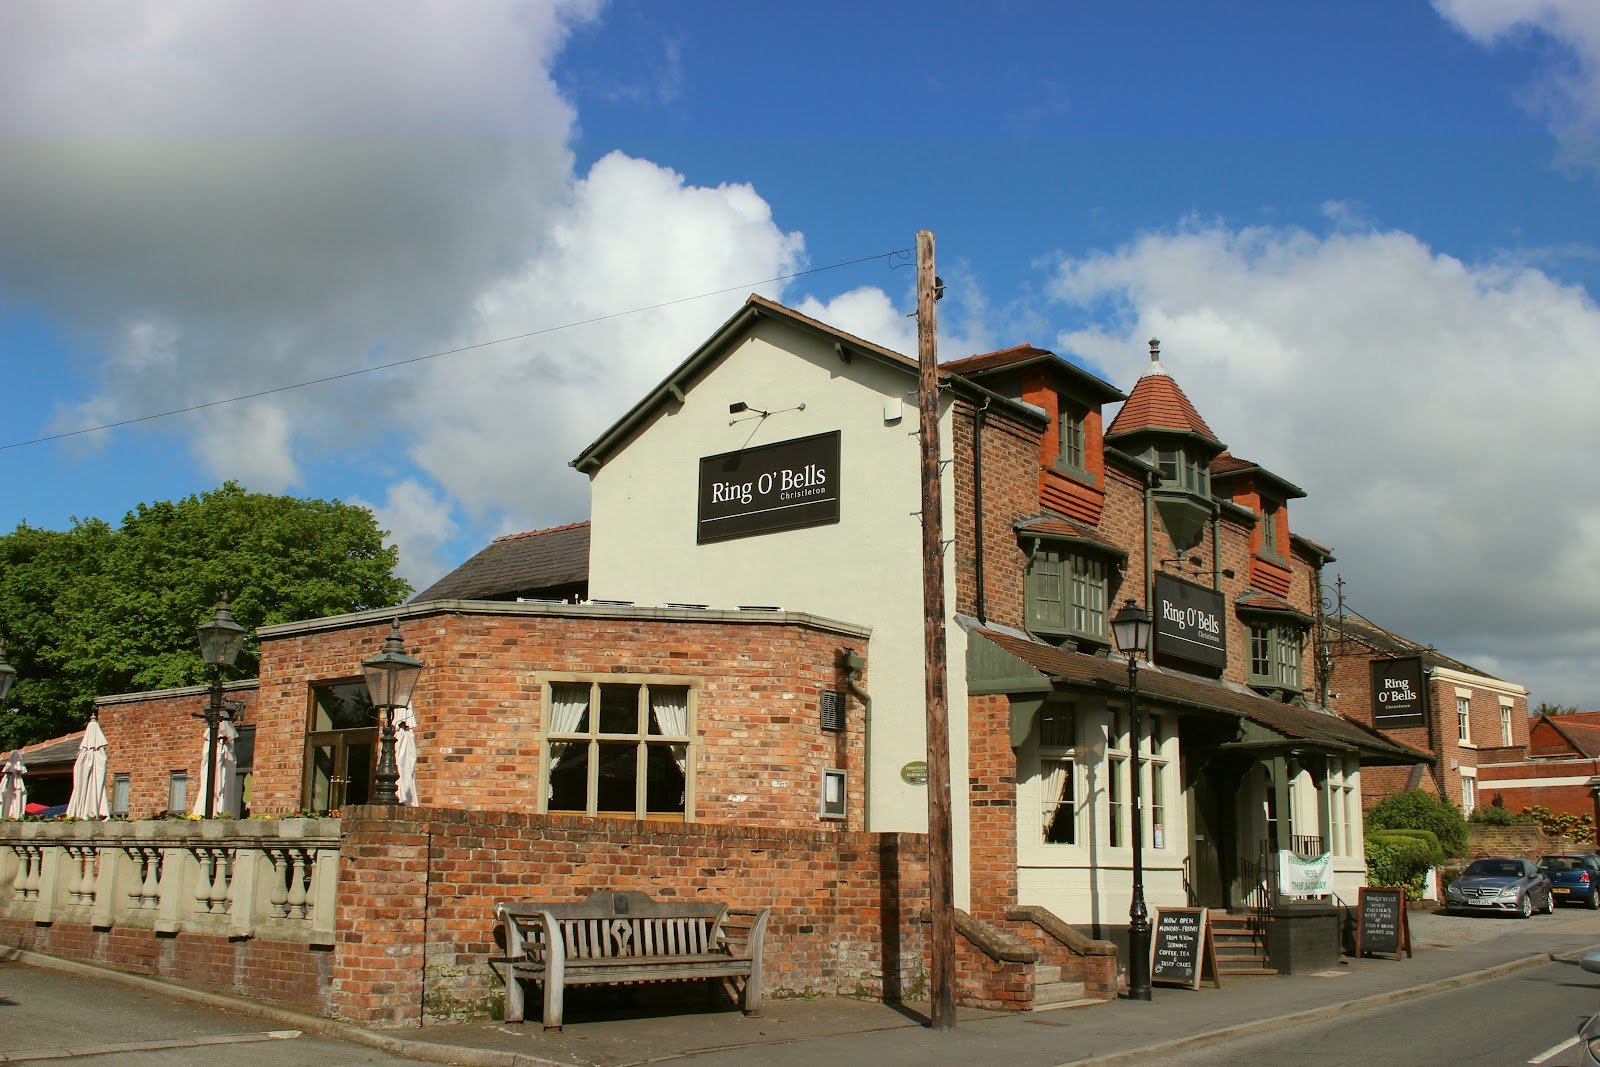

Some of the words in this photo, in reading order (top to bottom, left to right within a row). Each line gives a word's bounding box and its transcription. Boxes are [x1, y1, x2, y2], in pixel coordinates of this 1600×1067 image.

[712, 482, 753, 505] Ring
[780, 464, 826, 491] Bells
[780, 487, 826, 500] Christleton
[1163, 600, 1186, 630] Ring
[1198, 611, 1219, 634] Bells
[1198, 630, 1219, 642] Christleton
[1384, 678, 1409, 690] Ring
[1391, 690, 1417, 701] Bells
[1292, 881, 1303, 890] THIS
[1304, 880, 1327, 890] SATAY
